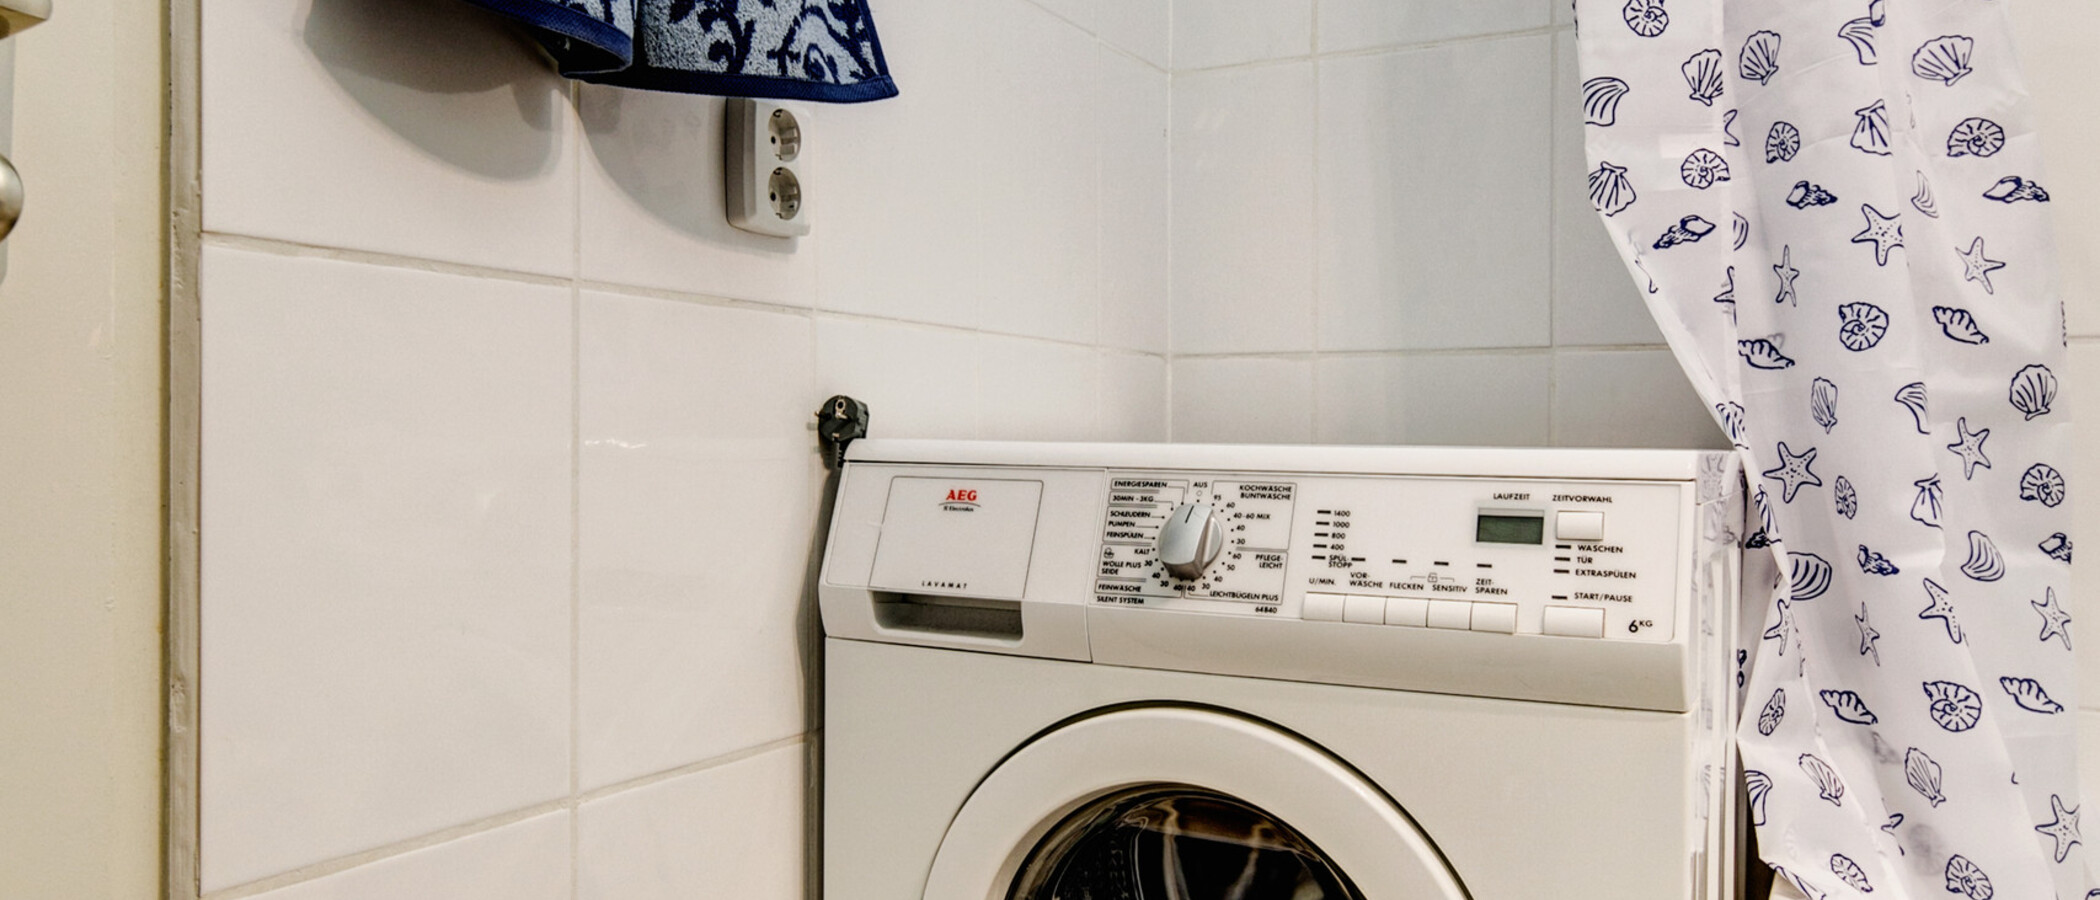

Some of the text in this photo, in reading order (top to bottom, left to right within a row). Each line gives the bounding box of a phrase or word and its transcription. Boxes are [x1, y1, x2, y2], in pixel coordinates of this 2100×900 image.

[945, 489, 977, 501] AEG
[1112, 494, 1134, 502] 30MIN
[1493, 492, 1530, 501] LAUFZEIT
[1552, 494, 1613, 504] ZEITVORWAHL
[1110, 510, 1151, 518] SCHLEUDERN
[1577, 544, 1624, 554] WASCHEN
[1102, 560, 1124, 568] WOLLE
[1328, 561, 1353, 569] STOPP
[1576, 556, 1593, 565] TÜR
[1259, 562, 1283, 570] LEICHT
[1101, 567, 1119, 575] SEIDE
[1575, 568, 1637, 579] EXTRASPÜLEN
[921, 580, 968, 589] LAVAMAT
[1389, 582, 1424, 591] FLECKEN
[1432, 584, 1468, 593] SENSITIV
[1475, 586, 1508, 595] SPAREN
[1209, 590, 1279, 601] LEICHTBÜGELN PLUS
[1574, 592, 1633, 603] START/PAUSE
